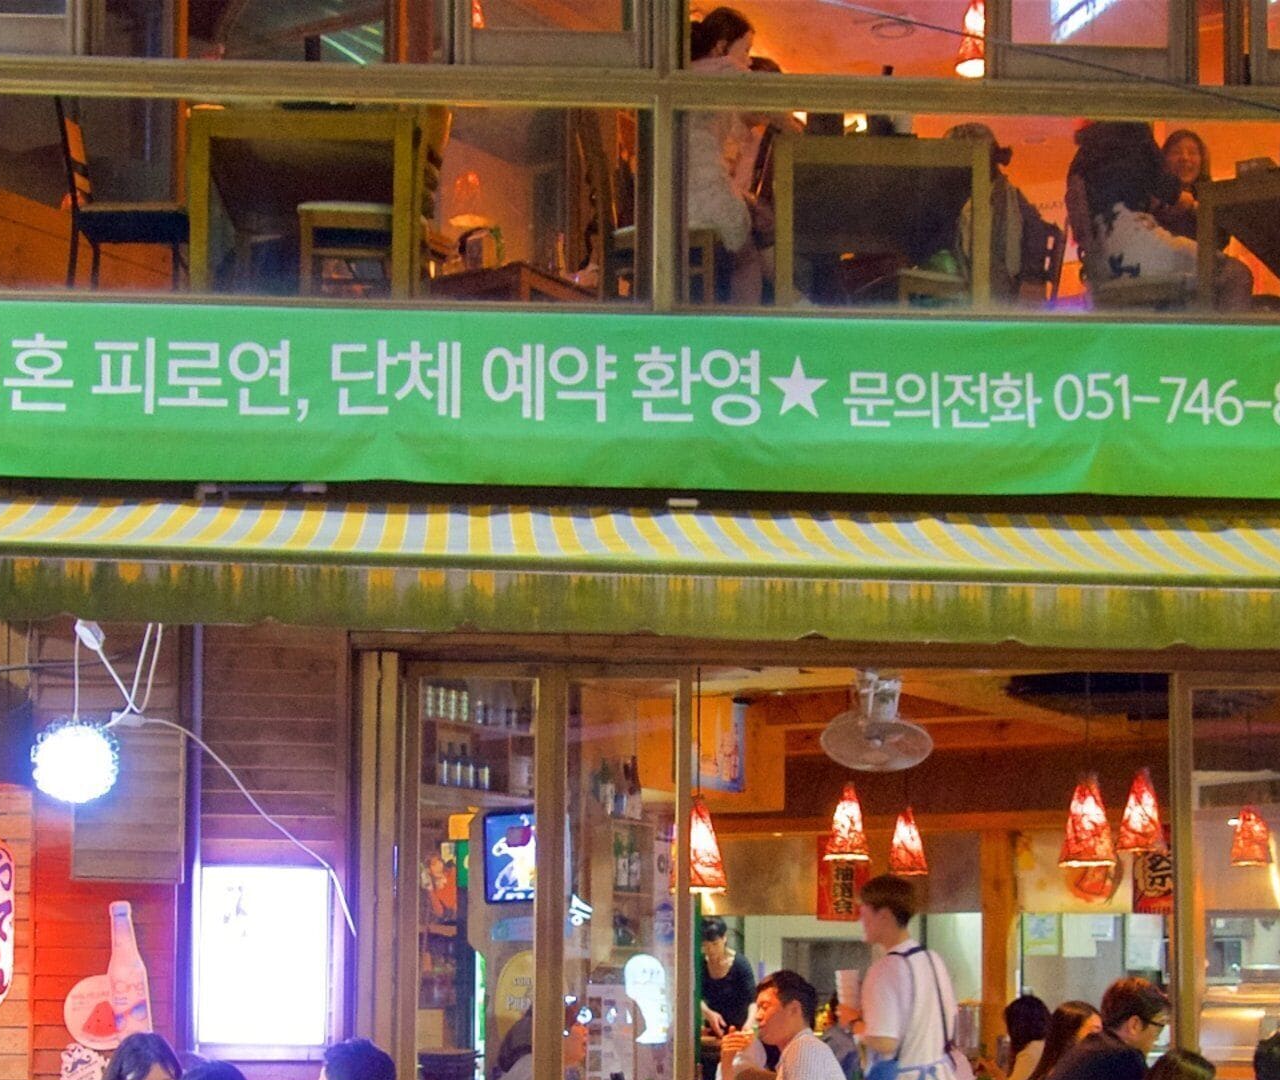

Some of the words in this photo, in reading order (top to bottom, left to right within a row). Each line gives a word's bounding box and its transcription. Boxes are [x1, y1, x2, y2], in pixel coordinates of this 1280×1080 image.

[91, 336, 310, 423] 피로연,
[330, 338, 462, 418] 단체
[481, 343, 618, 422] 예약
[631, 344, 762, 427] 환영
[842, 370, 1042, 429] 문의전화
